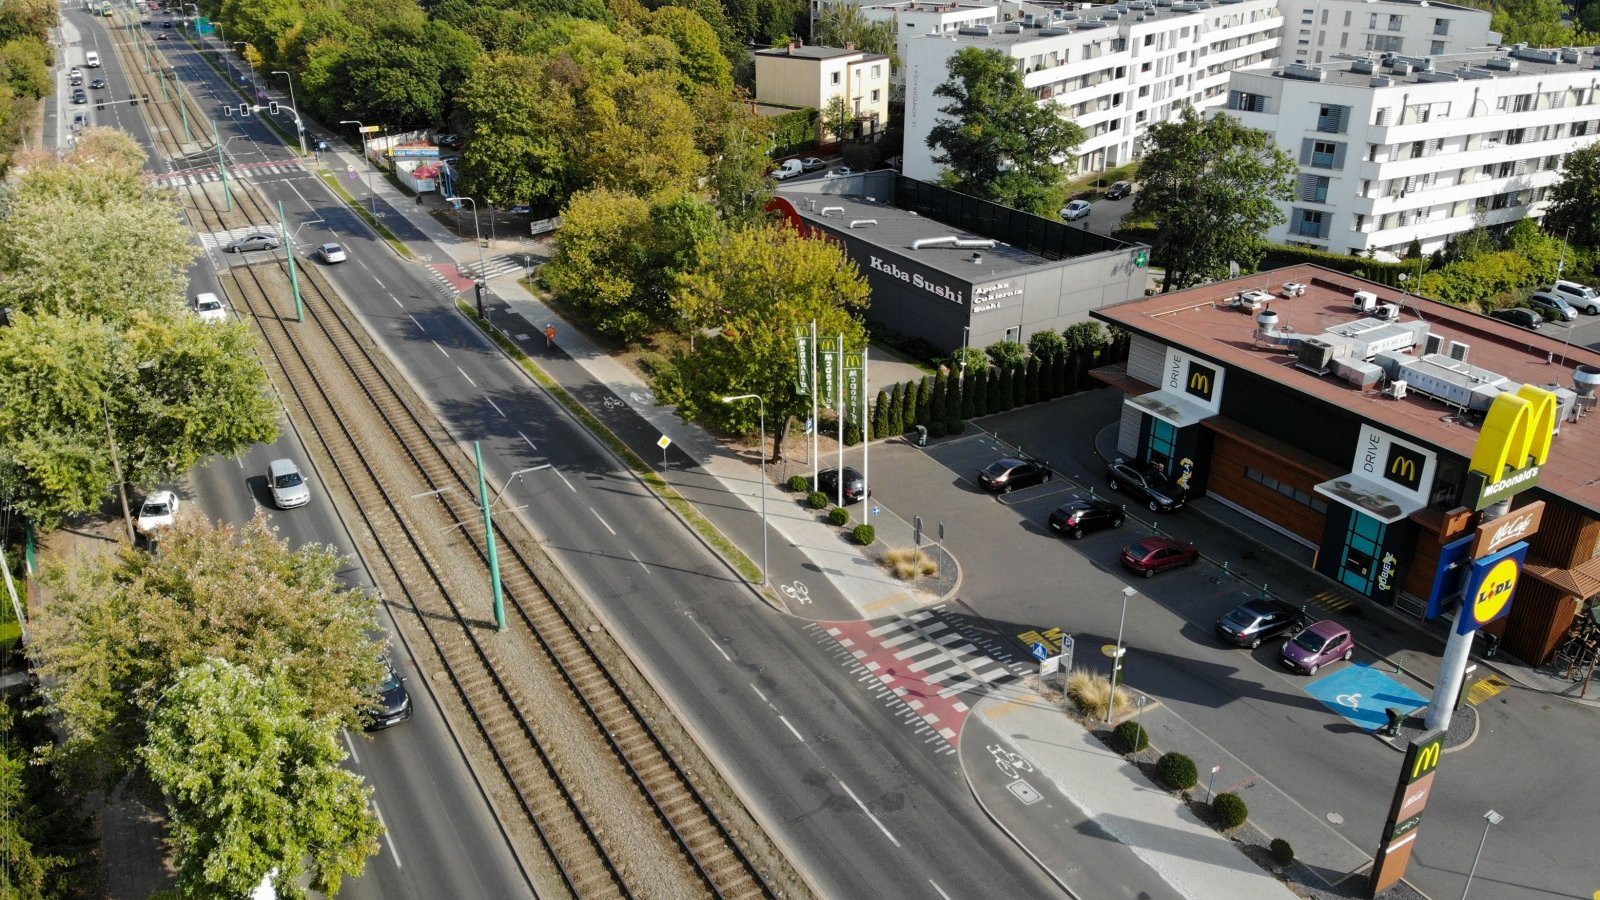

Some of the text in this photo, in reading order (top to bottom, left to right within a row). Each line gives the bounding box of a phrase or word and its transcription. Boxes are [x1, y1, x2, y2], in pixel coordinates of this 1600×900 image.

[869, 255, 963, 305] Kaba Sushi
[973, 288, 1023, 304] Cukiernia
[974, 282, 1009, 295] Apteka
[972, 302, 1001, 313] Sushi
[1169, 353, 1182, 389] DRIVE
[1363, 433, 1381, 473] DRIVE
[1483, 466, 1539, 498] McDonald's
